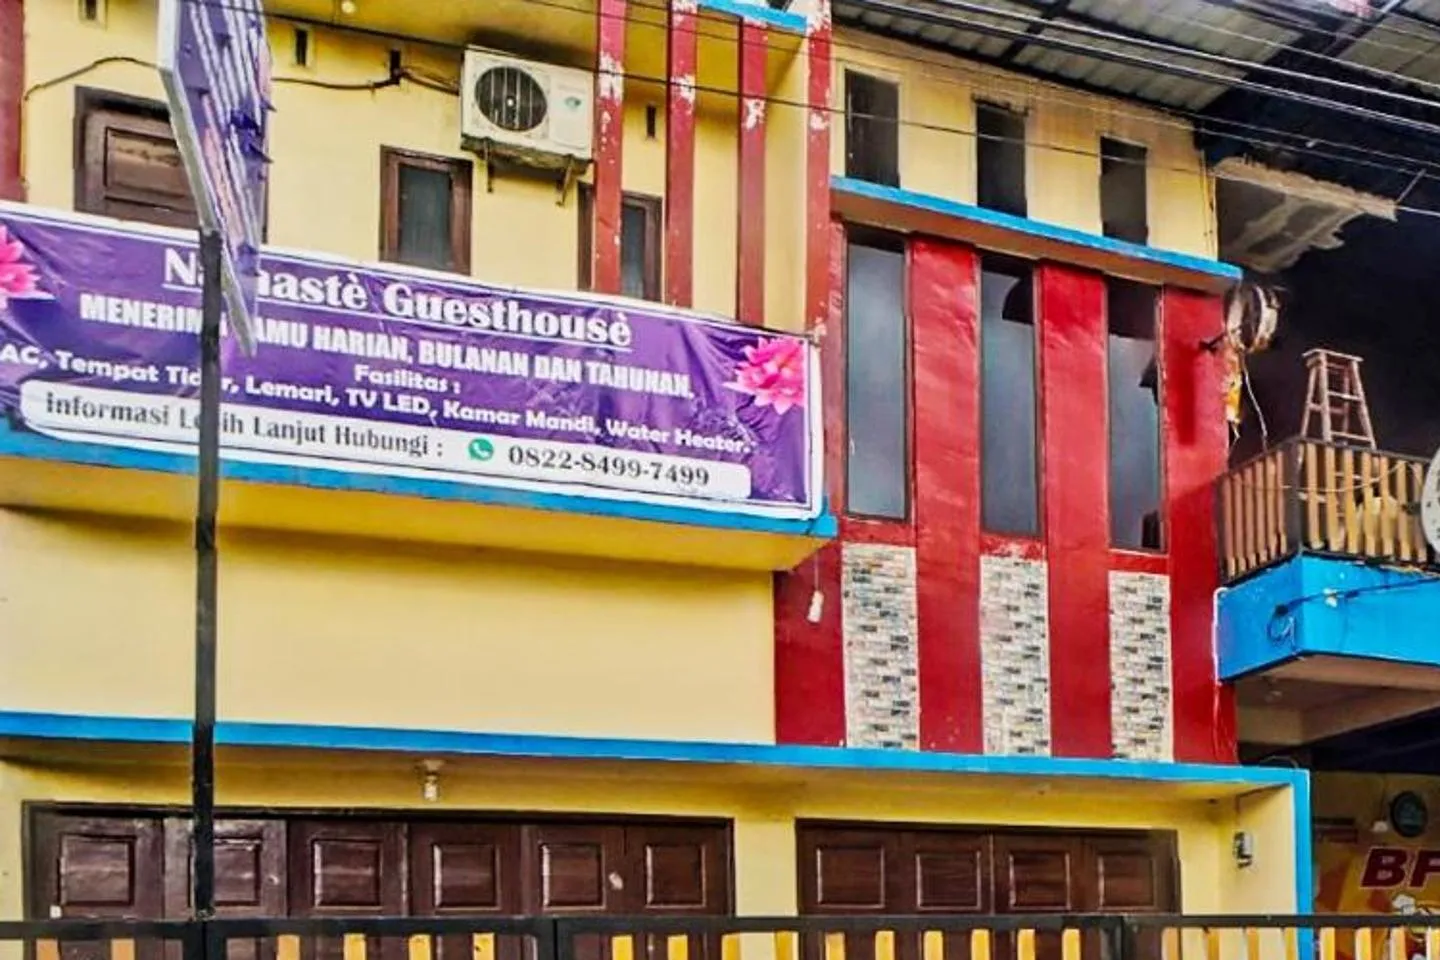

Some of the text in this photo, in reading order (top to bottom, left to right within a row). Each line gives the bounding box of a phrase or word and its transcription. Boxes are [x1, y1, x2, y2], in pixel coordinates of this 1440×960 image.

[383, 283, 632, 346] Guesthousè
[252, 317, 308, 348] AMU
[418, 339, 528, 378] BULANAN
[534, 357, 582, 383] DAN
[353, 364, 448, 393] Fasilitas
[0, 343, 48, 369] AC,
[55, 350, 159, 383] Tempat
[166, 365, 240, 394] Tidr,
[245, 376, 341, 407] Lemari,
[346, 388, 377, 408] TV
[383, 394, 438, 418] LED,
[443, 401, 522, 425] Kamar
[525, 410, 601, 436] Mandi,
[605, 420, 671, 443] Water
[179, 406, 243, 433] Leih
[254, 417, 326, 445] Lanjut
[335, 425, 429, 457] Hubungi
[508, 445, 710, 486] 0822-8499-7499
